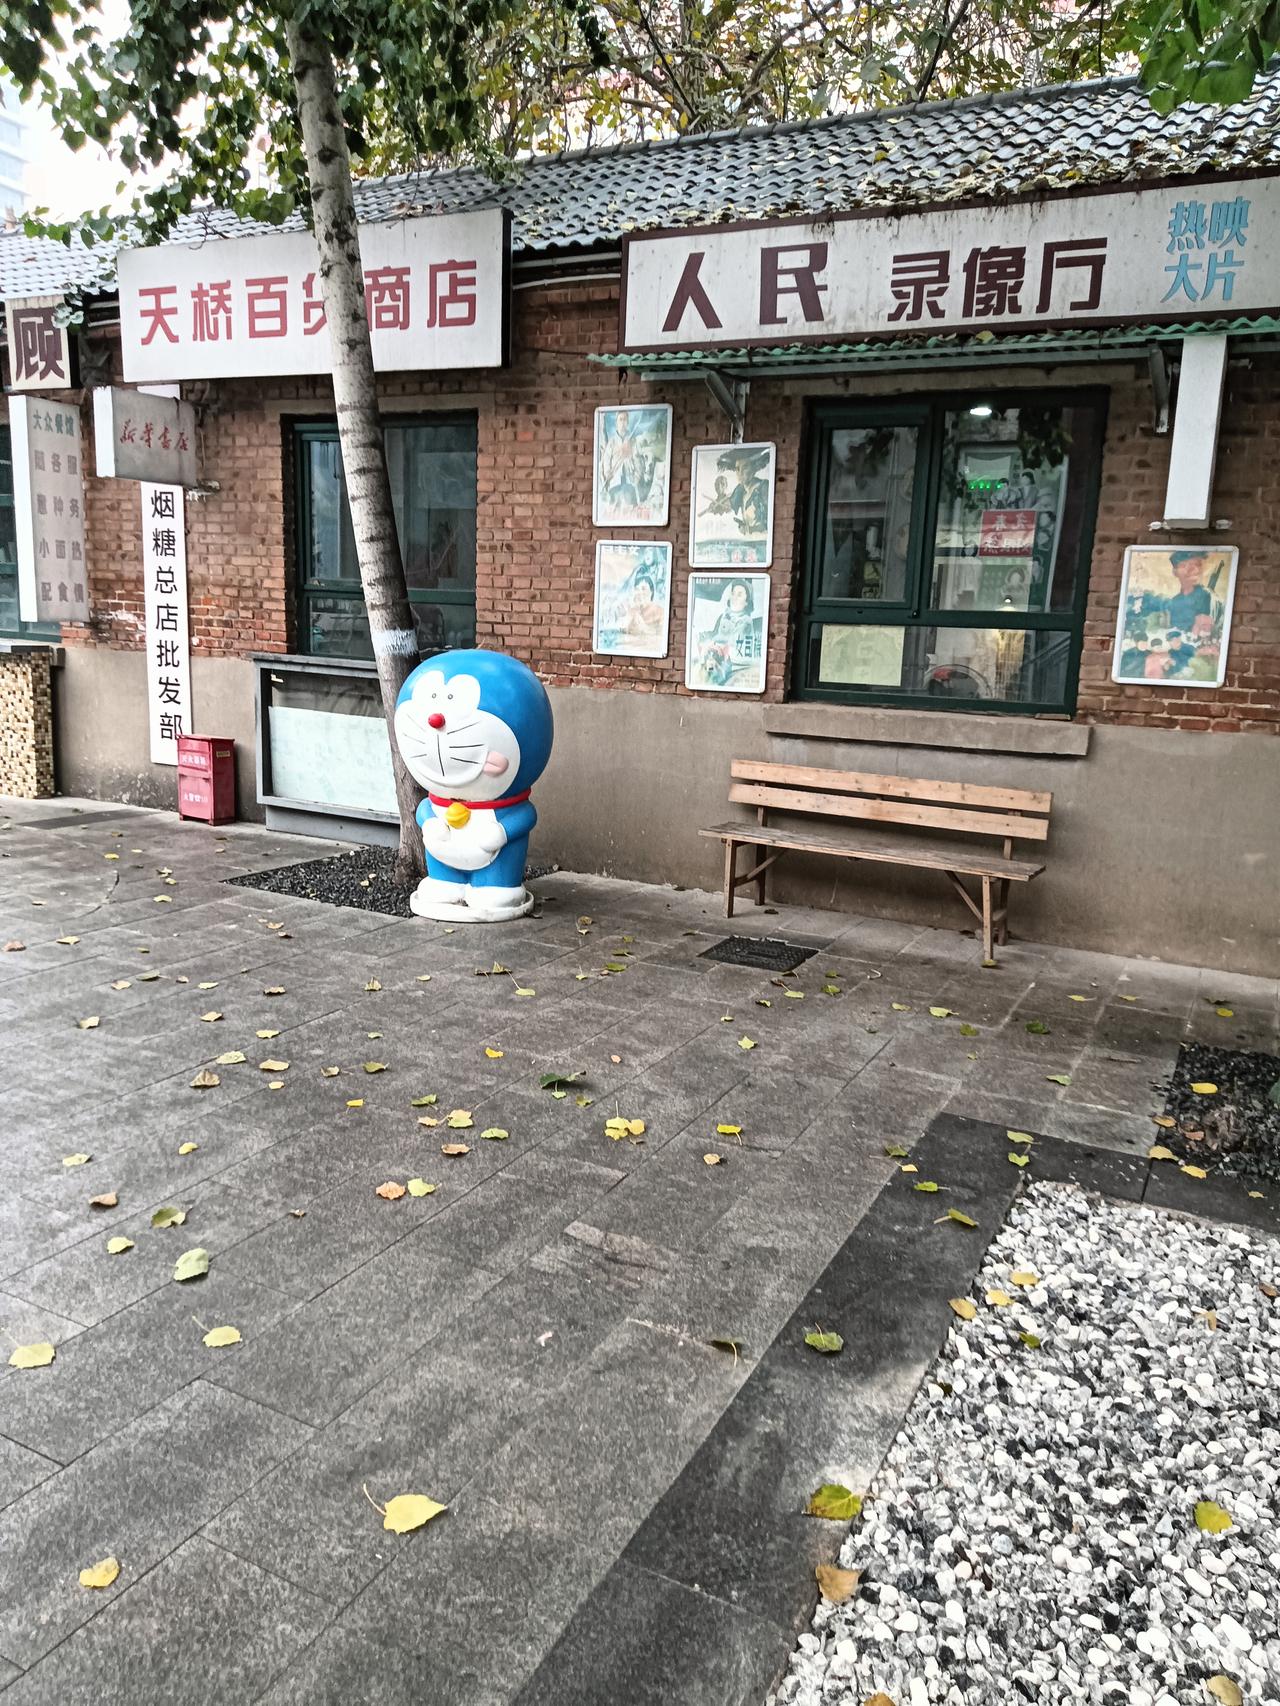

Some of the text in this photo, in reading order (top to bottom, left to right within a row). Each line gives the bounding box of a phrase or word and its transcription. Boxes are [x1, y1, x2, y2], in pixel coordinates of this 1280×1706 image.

[1166, 195, 1251, 255] 热映
[1160, 249, 1245, 304] 大片
[33, 410, 75, 437] 大众餐馆
[150, 489, 184, 741] 烟糖总店批发部
